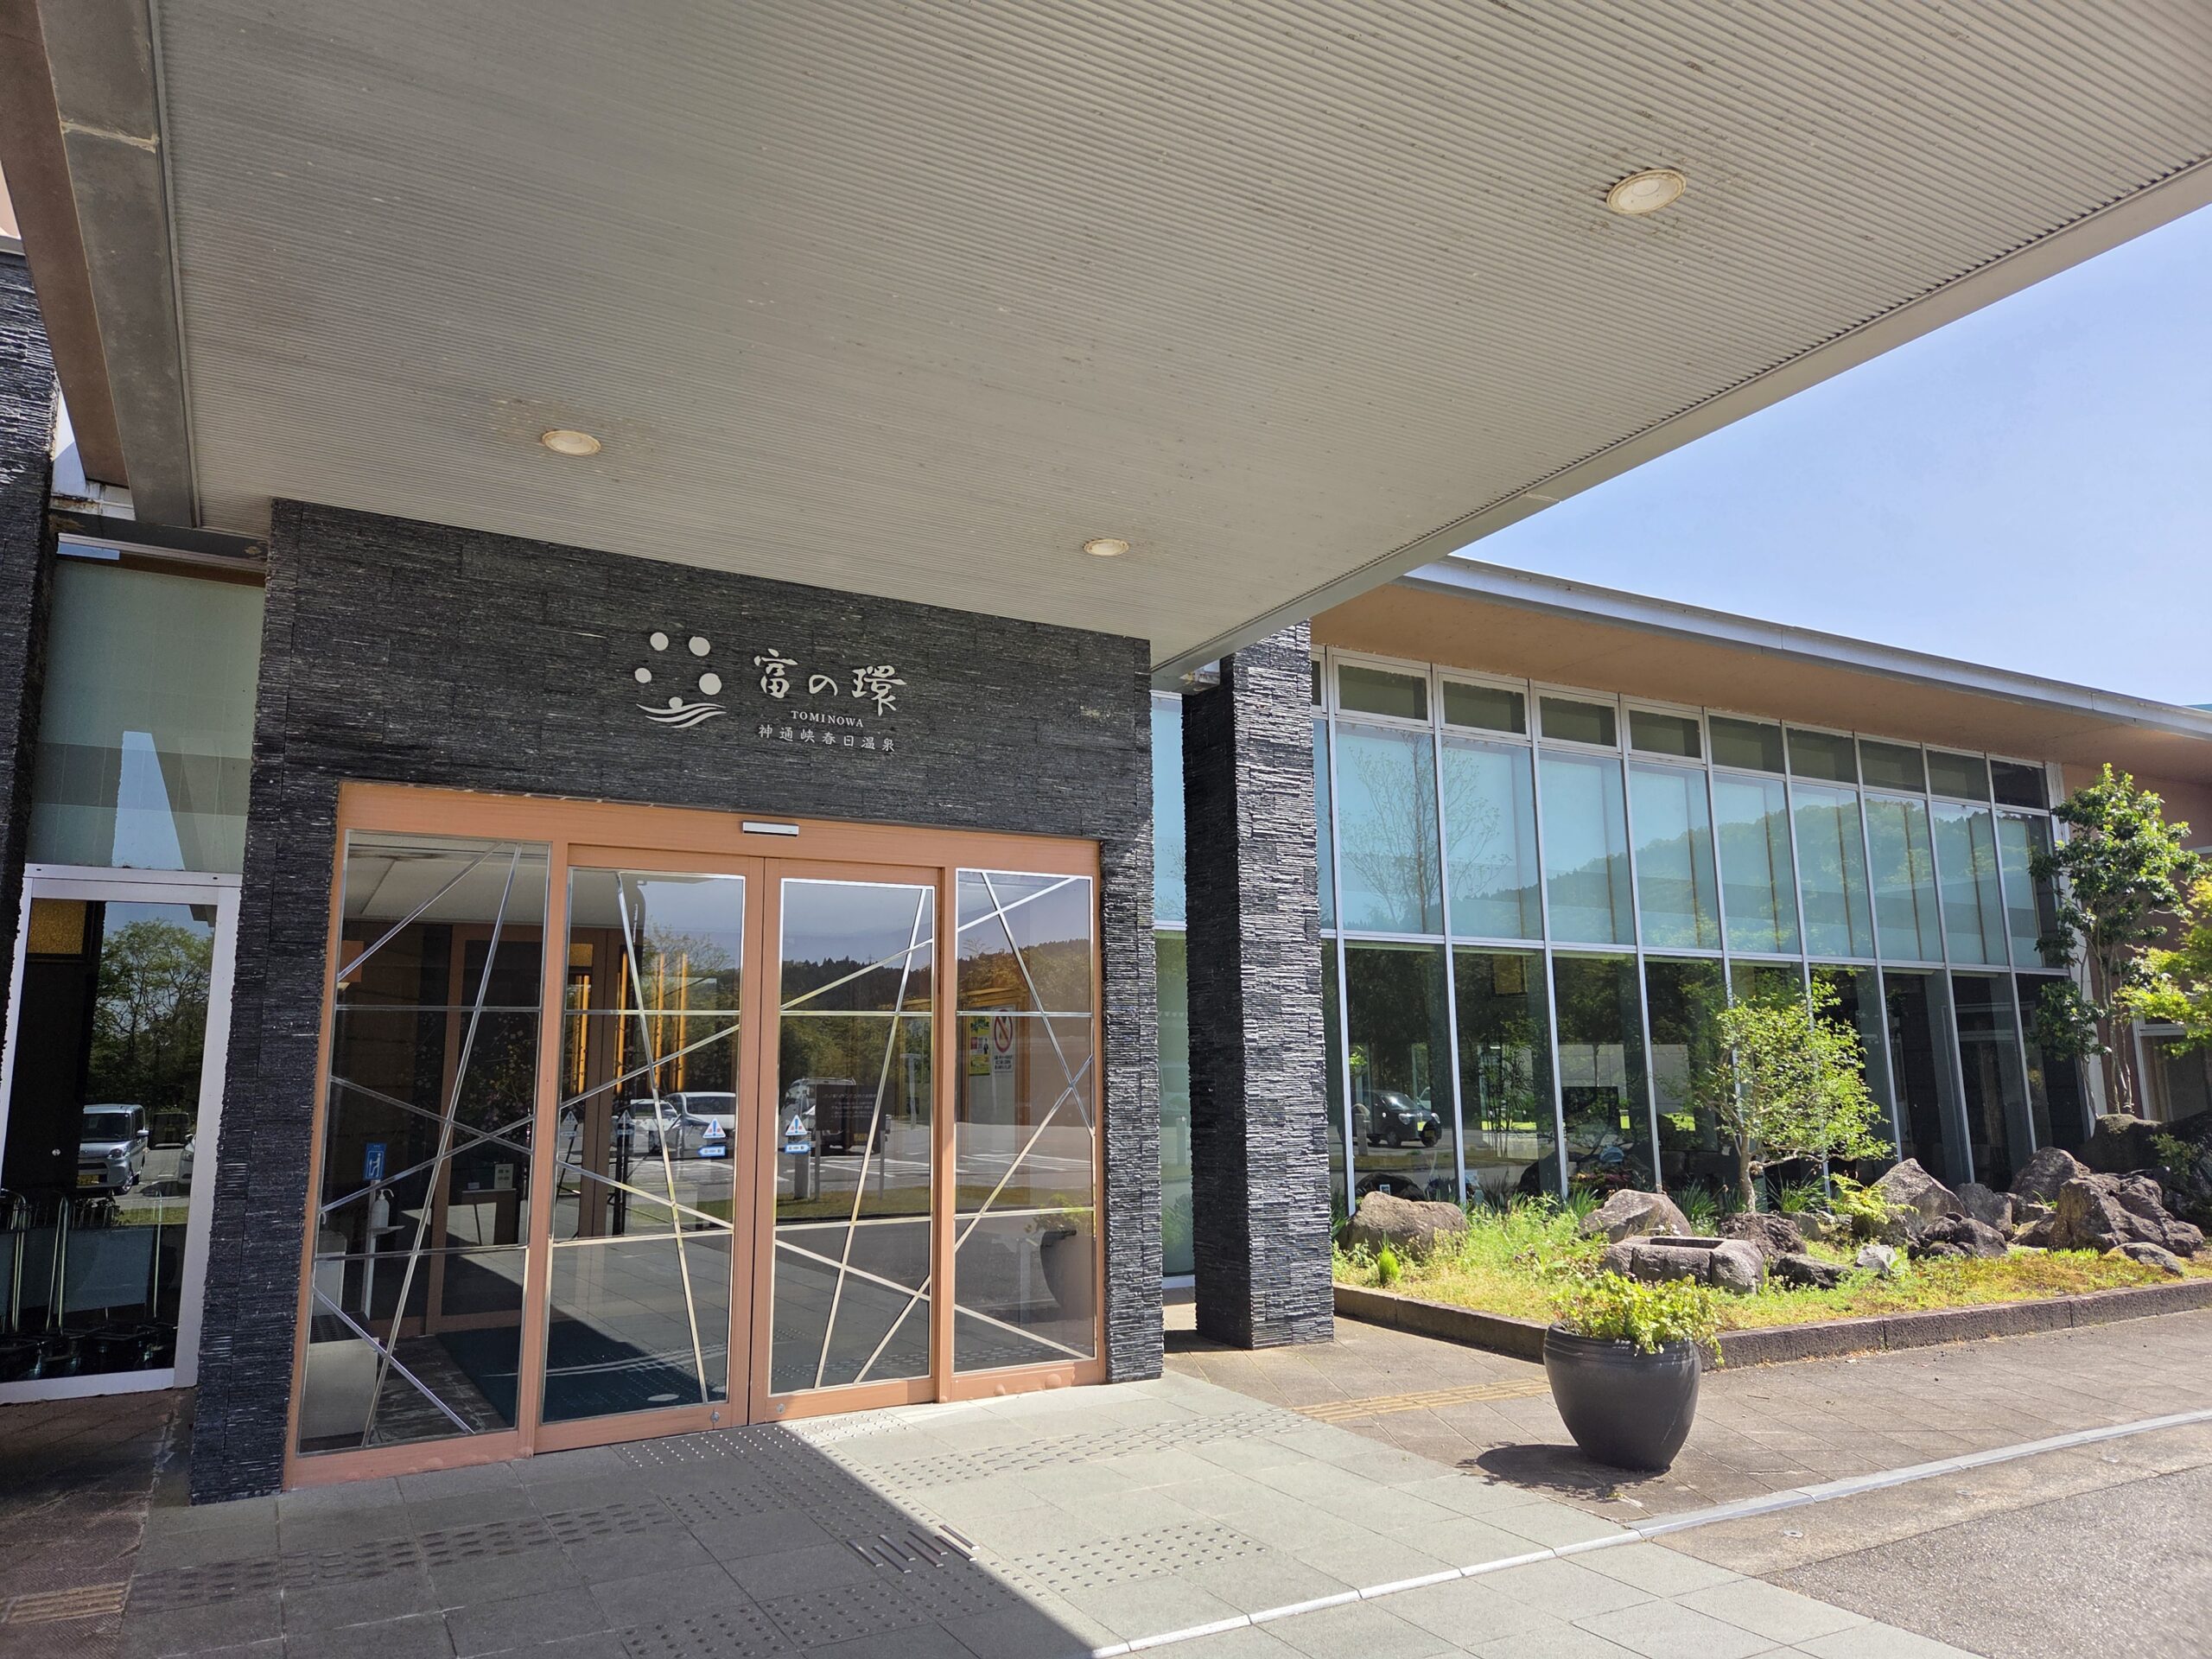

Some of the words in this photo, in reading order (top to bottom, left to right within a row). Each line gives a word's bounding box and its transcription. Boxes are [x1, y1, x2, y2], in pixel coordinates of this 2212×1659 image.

[753, 648, 907, 716] 富の環
[791, 710, 864, 728] TOMINOWA
[758, 724, 895, 752] 神通峡春日温泉
